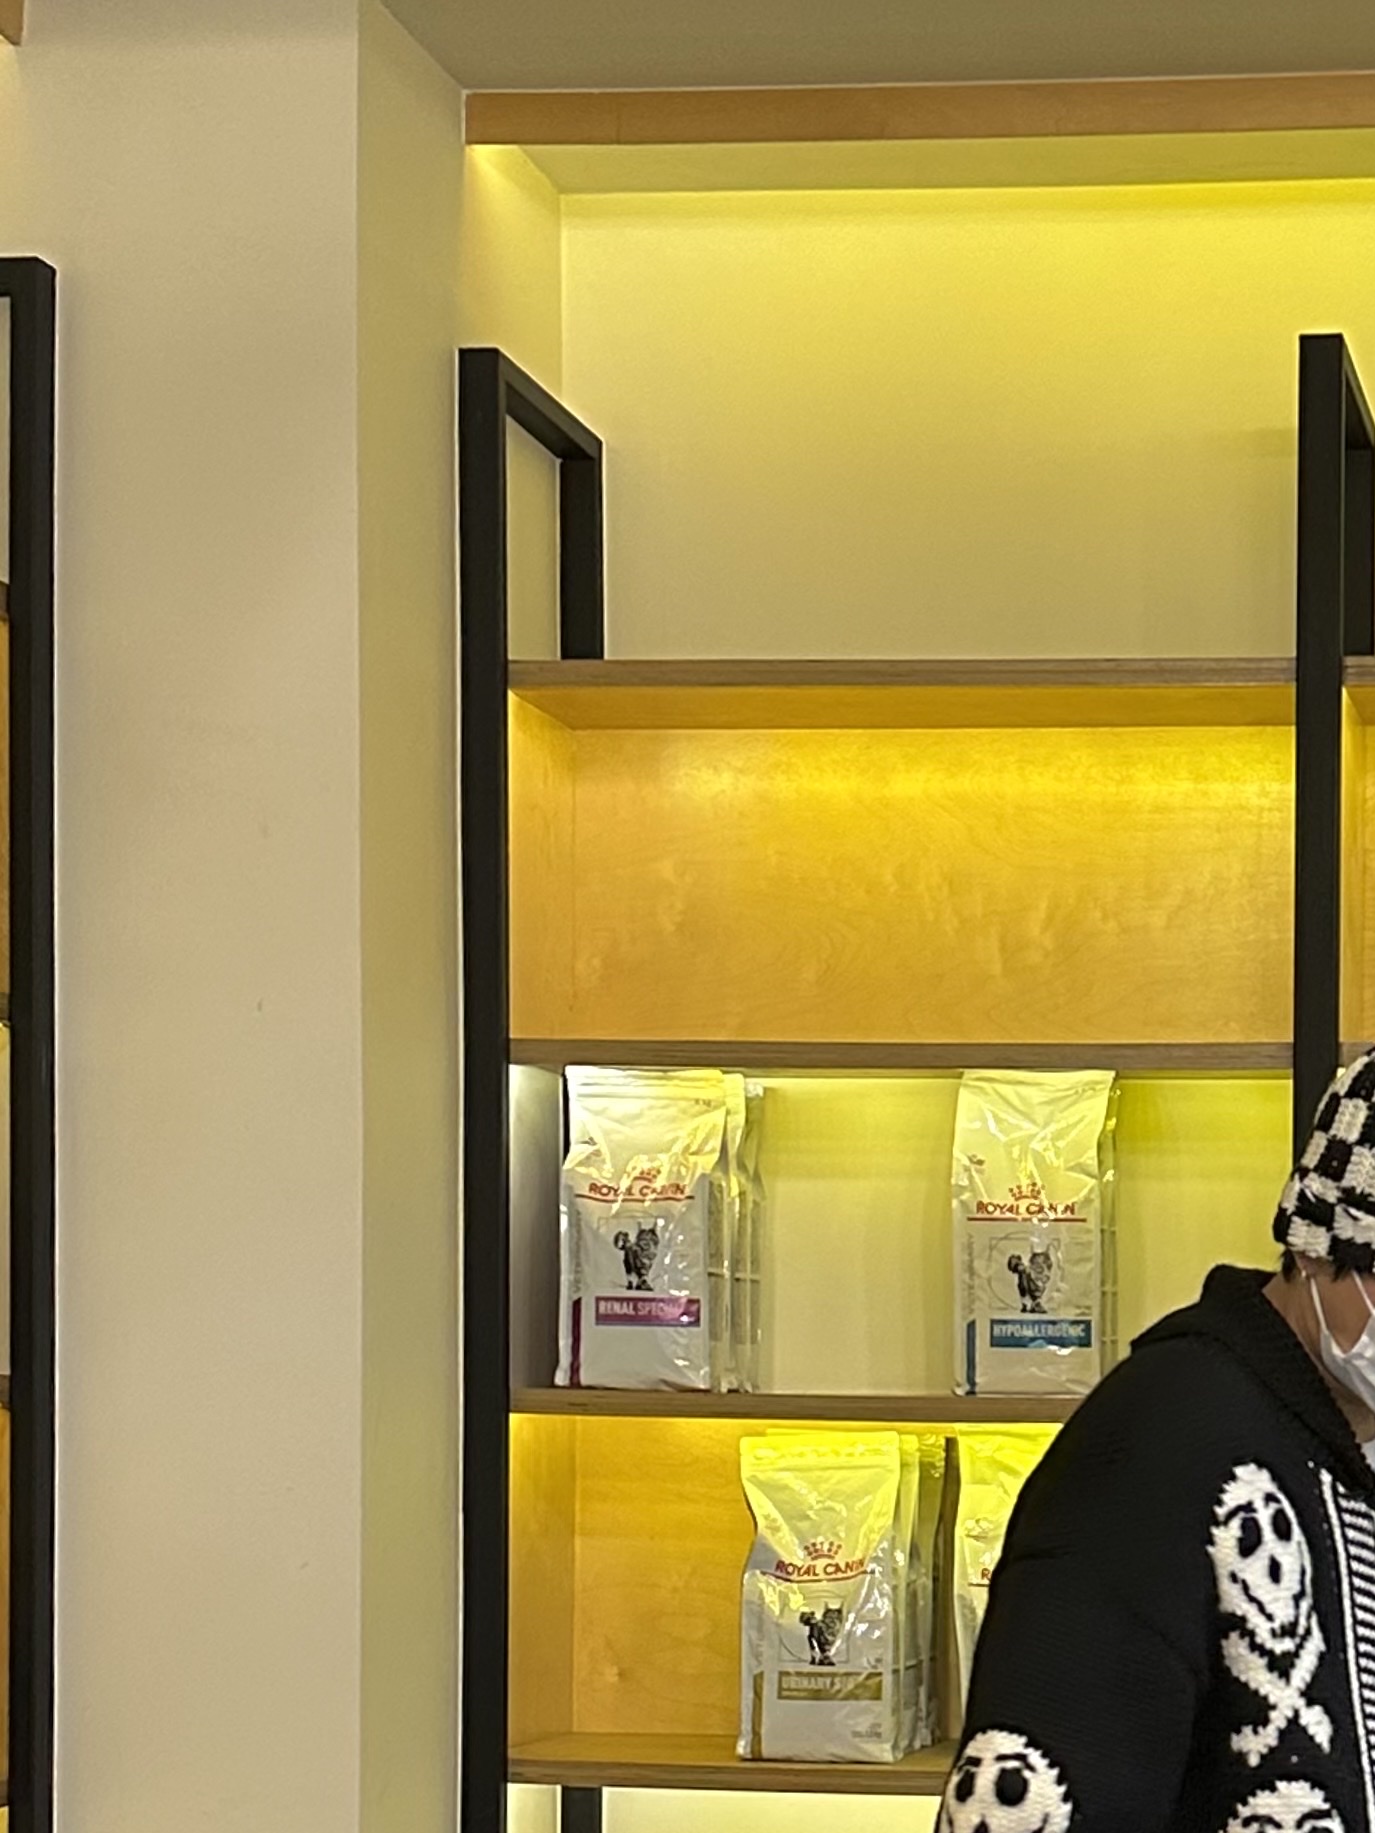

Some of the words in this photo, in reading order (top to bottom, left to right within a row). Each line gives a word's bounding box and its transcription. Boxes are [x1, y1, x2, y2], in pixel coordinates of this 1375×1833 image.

[976, 1201, 1020, 1215] ROYAL
[599, 1301, 635, 1315] RENAL
[775, 1560, 821, 1577] ROYAL
